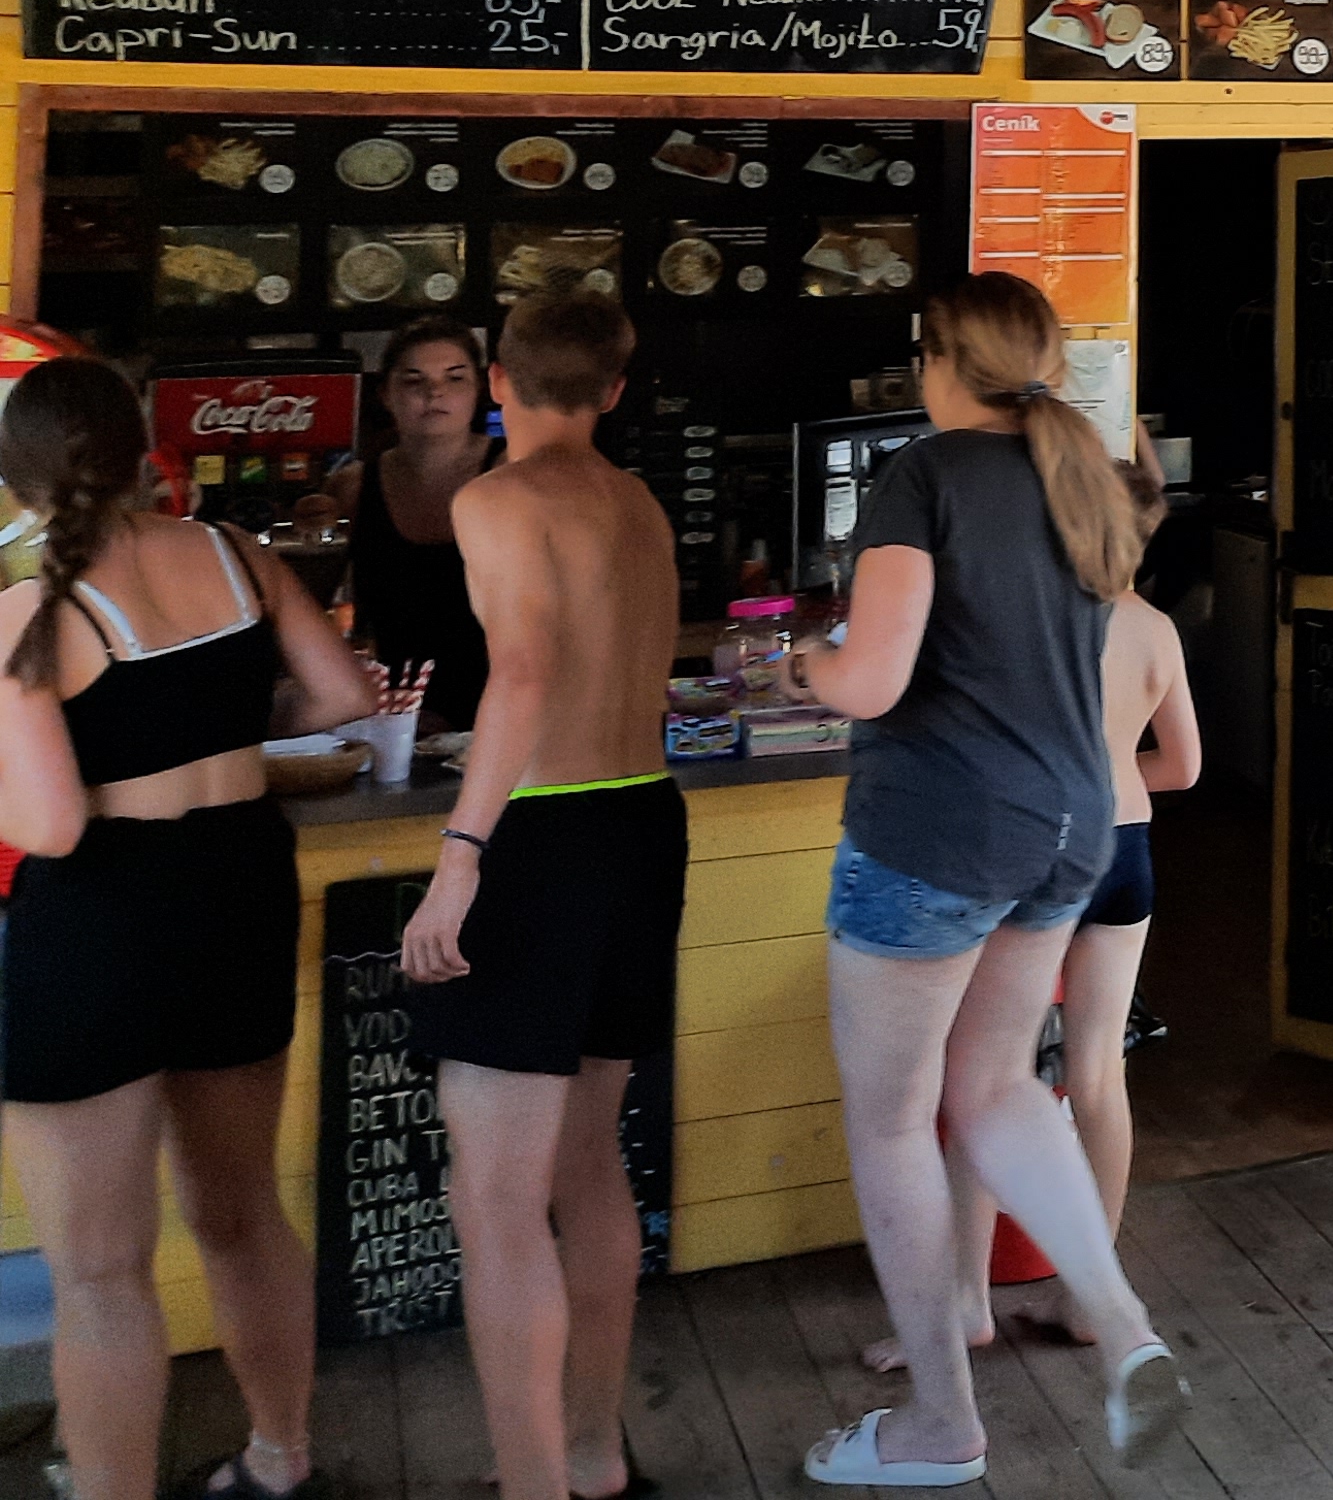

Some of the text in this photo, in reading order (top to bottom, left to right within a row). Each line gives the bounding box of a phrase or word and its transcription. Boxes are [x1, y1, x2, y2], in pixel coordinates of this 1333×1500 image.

[55, 15, 298, 61] Capri-Sun
[982, 115, 1041, 132] Ceník
[349, 1088, 441, 1134] BETO
[347, 1128, 450, 1176] GIN T
[347, 1170, 421, 1208] CUBA
[350, 1194, 452, 1242] MIMOS
